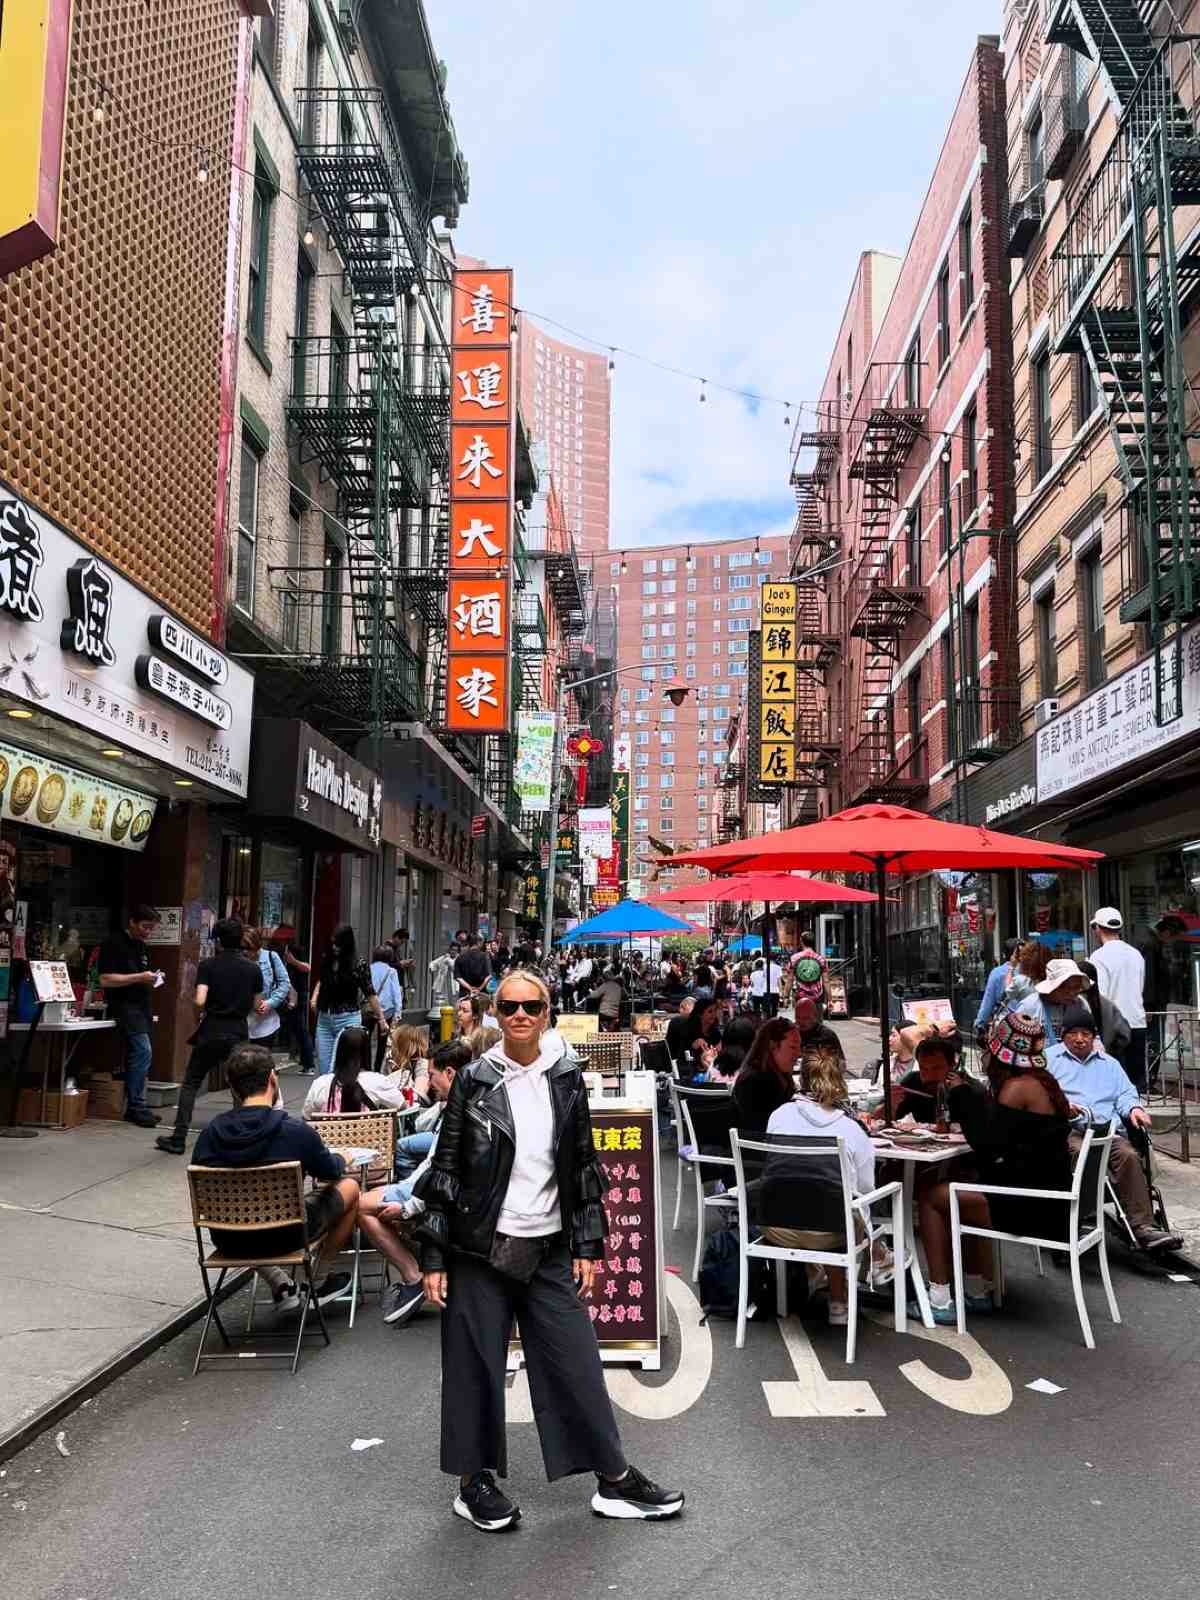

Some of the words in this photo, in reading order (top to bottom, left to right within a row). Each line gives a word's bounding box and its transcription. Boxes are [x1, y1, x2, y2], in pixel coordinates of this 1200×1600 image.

[763, 601, 795, 616] Ginger
[768, 587, 790, 601] Joe's
[166, 623, 223, 678] 四川小炒
[764, 626, 792, 778] 錦江飯店
